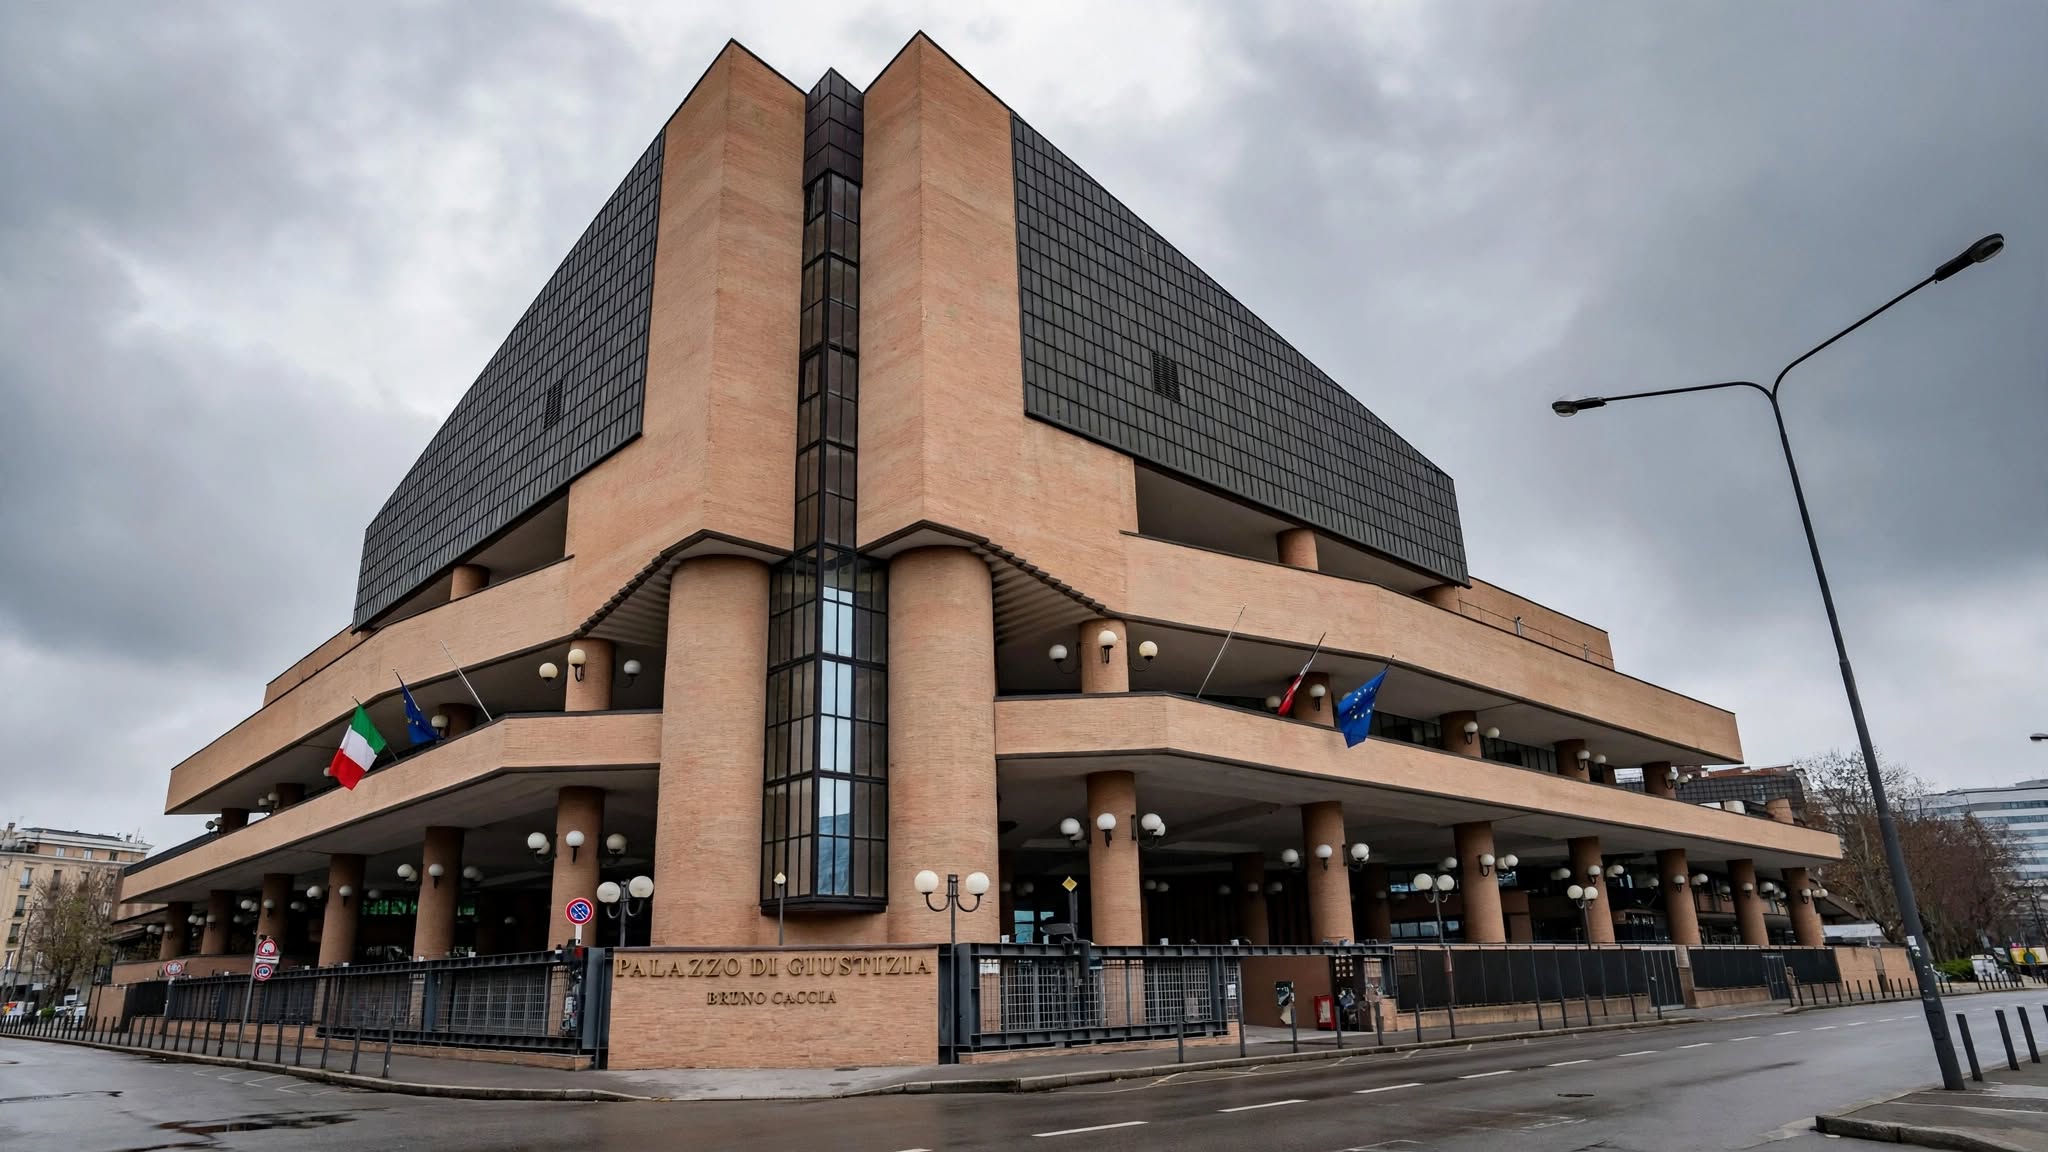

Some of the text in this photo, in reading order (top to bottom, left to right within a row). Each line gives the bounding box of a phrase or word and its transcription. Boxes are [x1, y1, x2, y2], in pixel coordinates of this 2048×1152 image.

[615, 955, 932, 978] PALAZZO DI GIUSTIZIA
[706, 991, 837, 1006] BRUNO CACCIA
